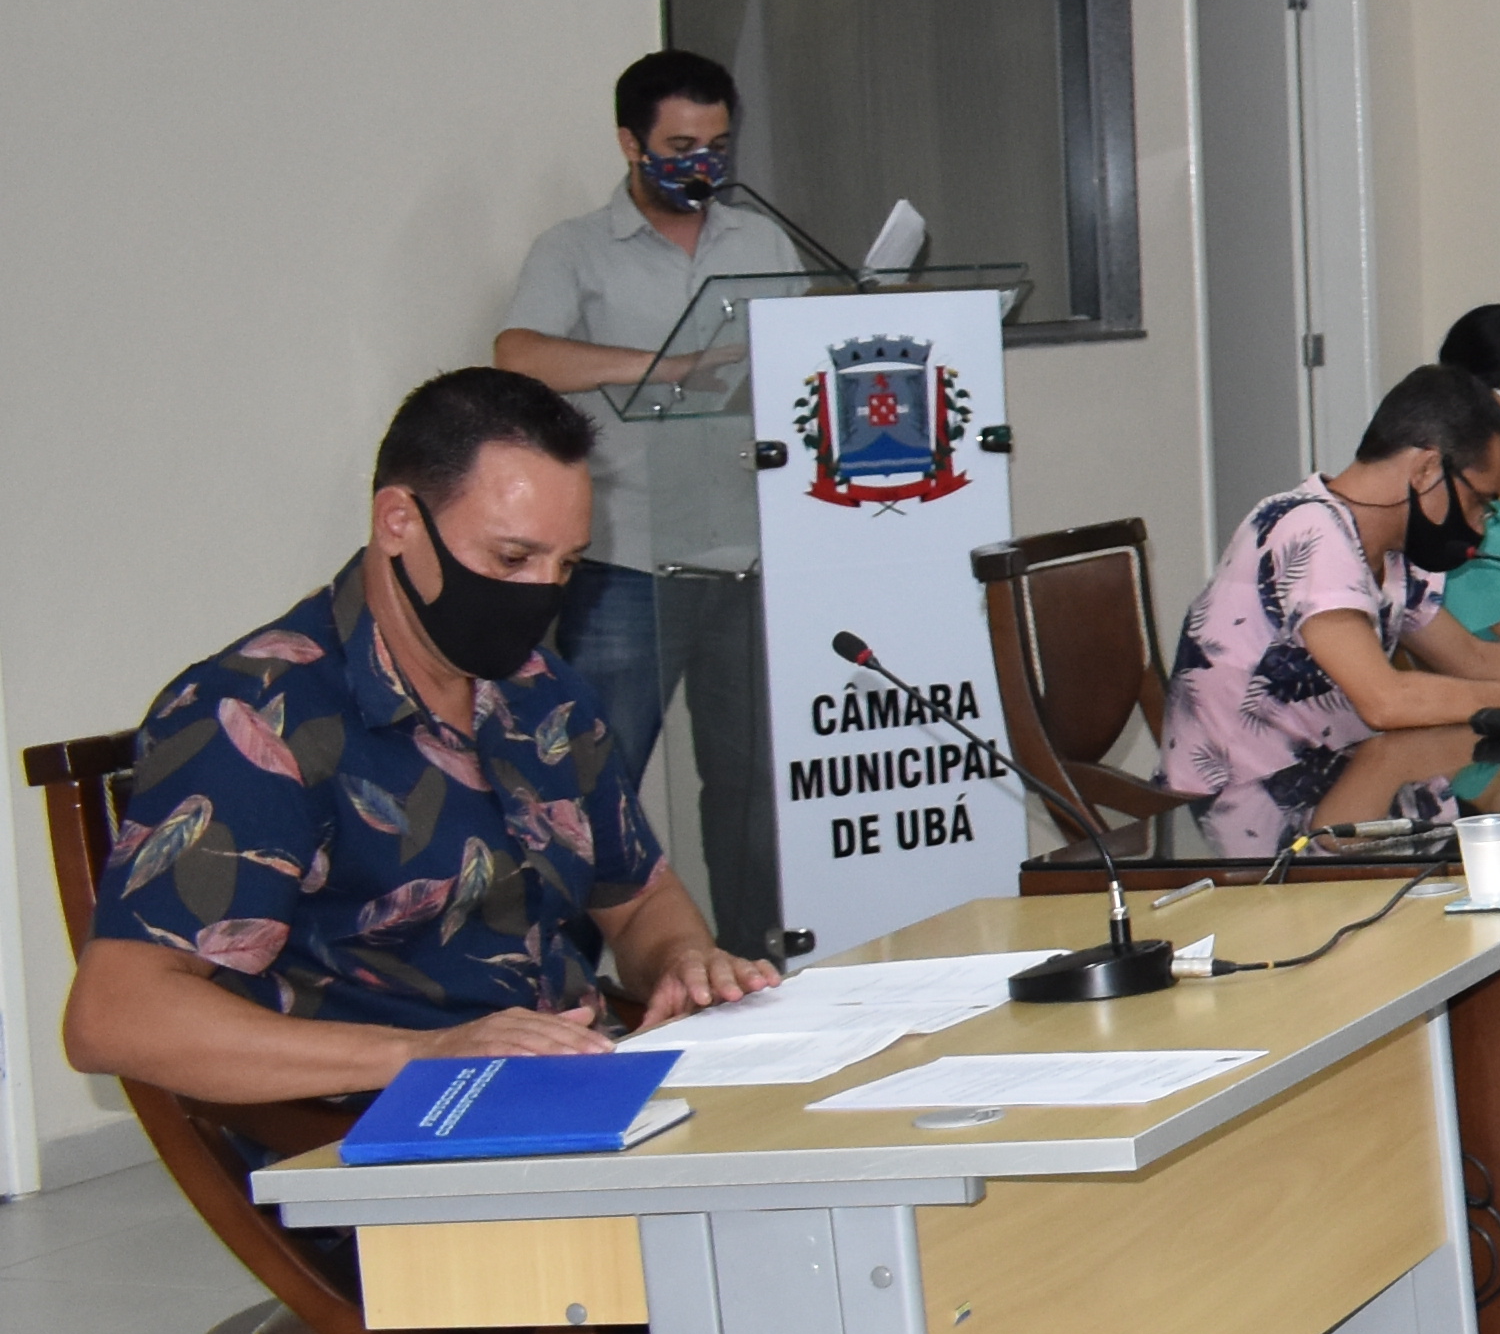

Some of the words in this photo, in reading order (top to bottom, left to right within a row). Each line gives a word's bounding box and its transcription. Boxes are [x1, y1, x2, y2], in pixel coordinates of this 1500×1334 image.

[811, 680, 980, 737] CÂMARA
[790, 738, 1008, 802] MUNICIPAL
[831, 814, 882, 859] DE
[896, 792, 975, 851] UBÁ
